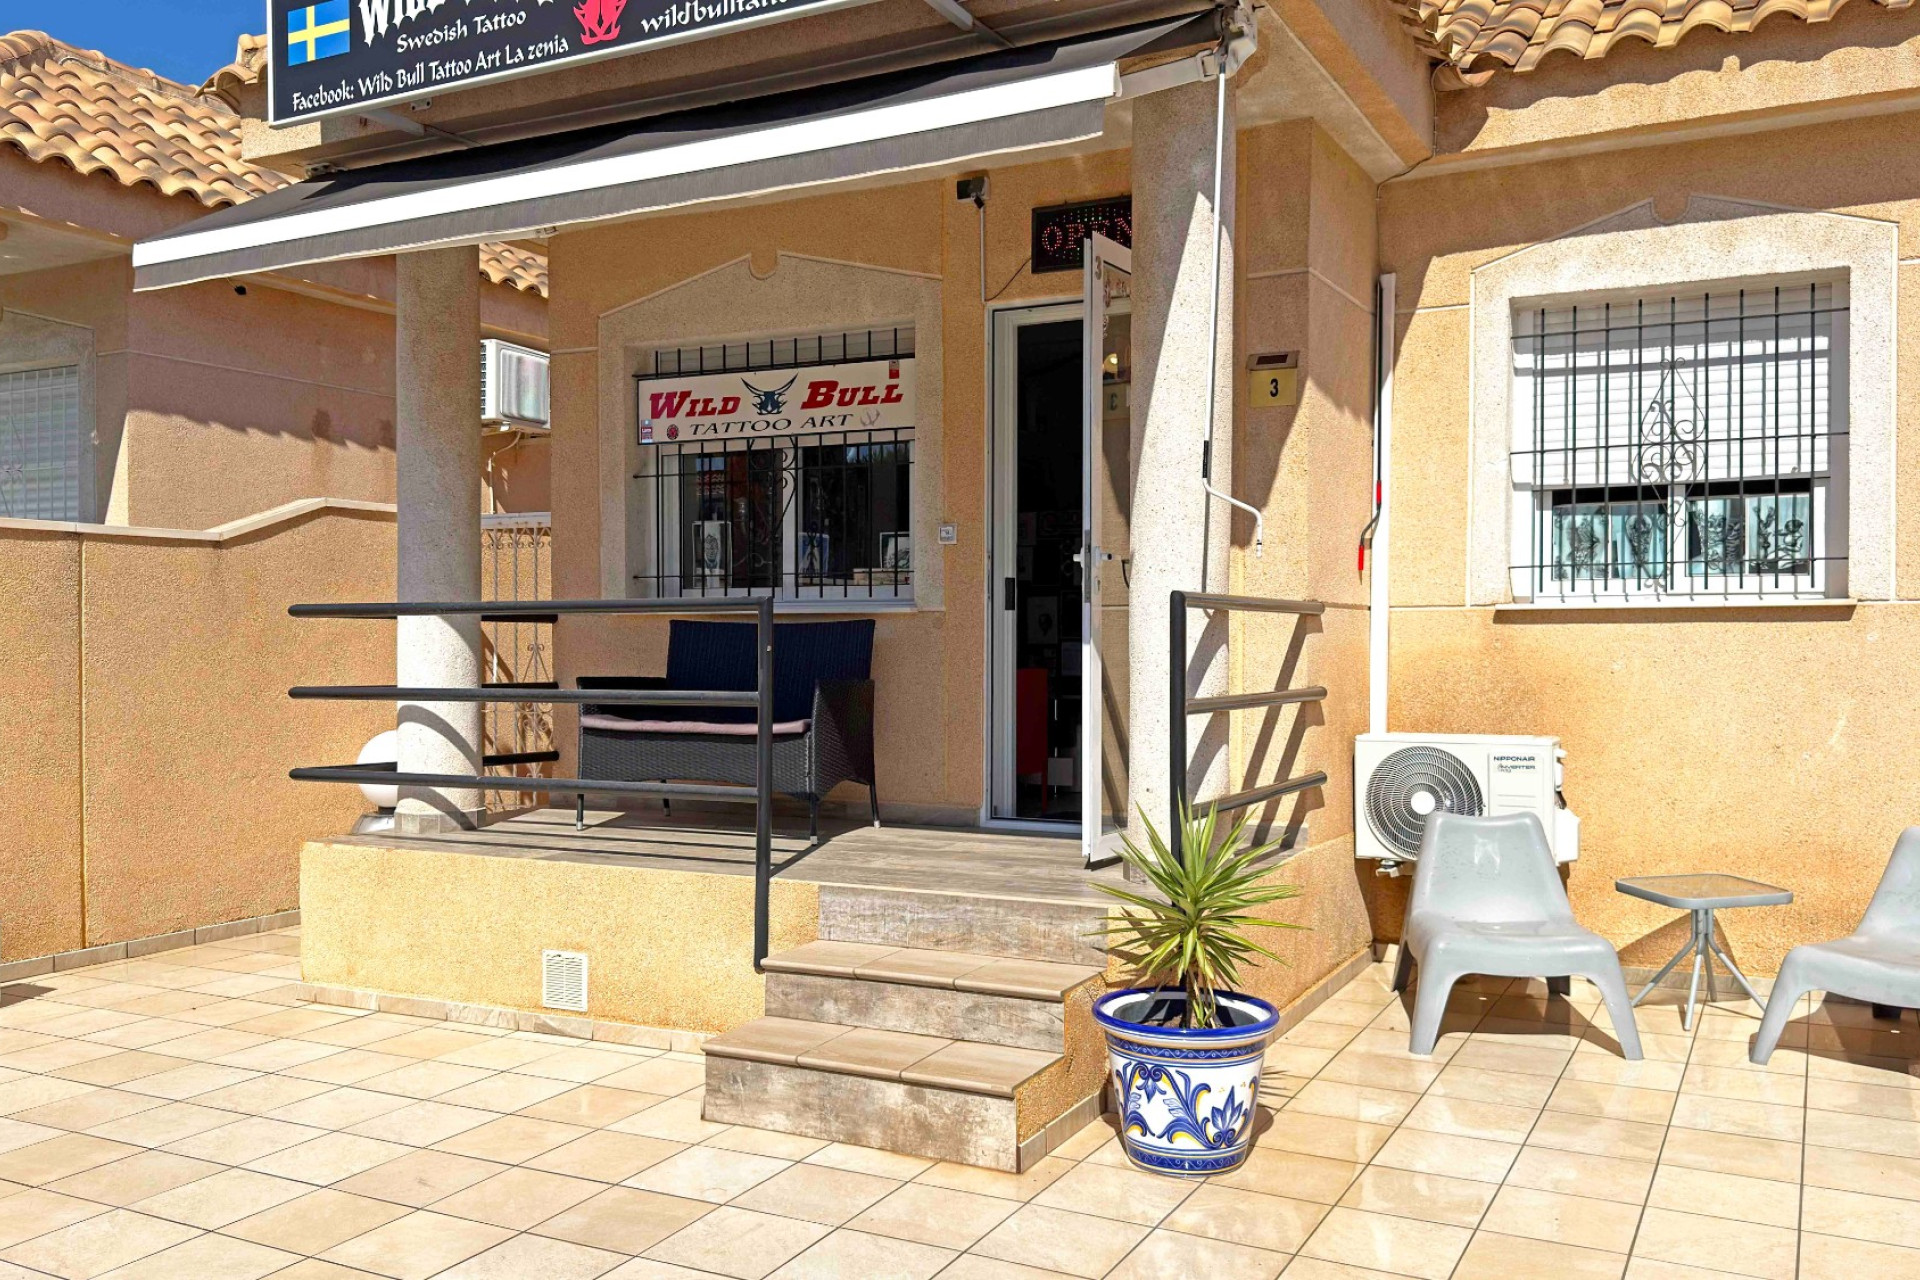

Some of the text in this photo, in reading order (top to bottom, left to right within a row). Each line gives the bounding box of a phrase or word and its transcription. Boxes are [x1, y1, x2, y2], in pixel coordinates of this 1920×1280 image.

[396, 10, 527, 54] Swedish Tattoo
[293, 34, 569, 112] Facebook: Wild Bull Tattoo Art La zenia
[649, 380, 904, 419] WILD BULL
[1270, 378, 1279, 398] 3
[690, 413, 854, 436] TATTOO ART
